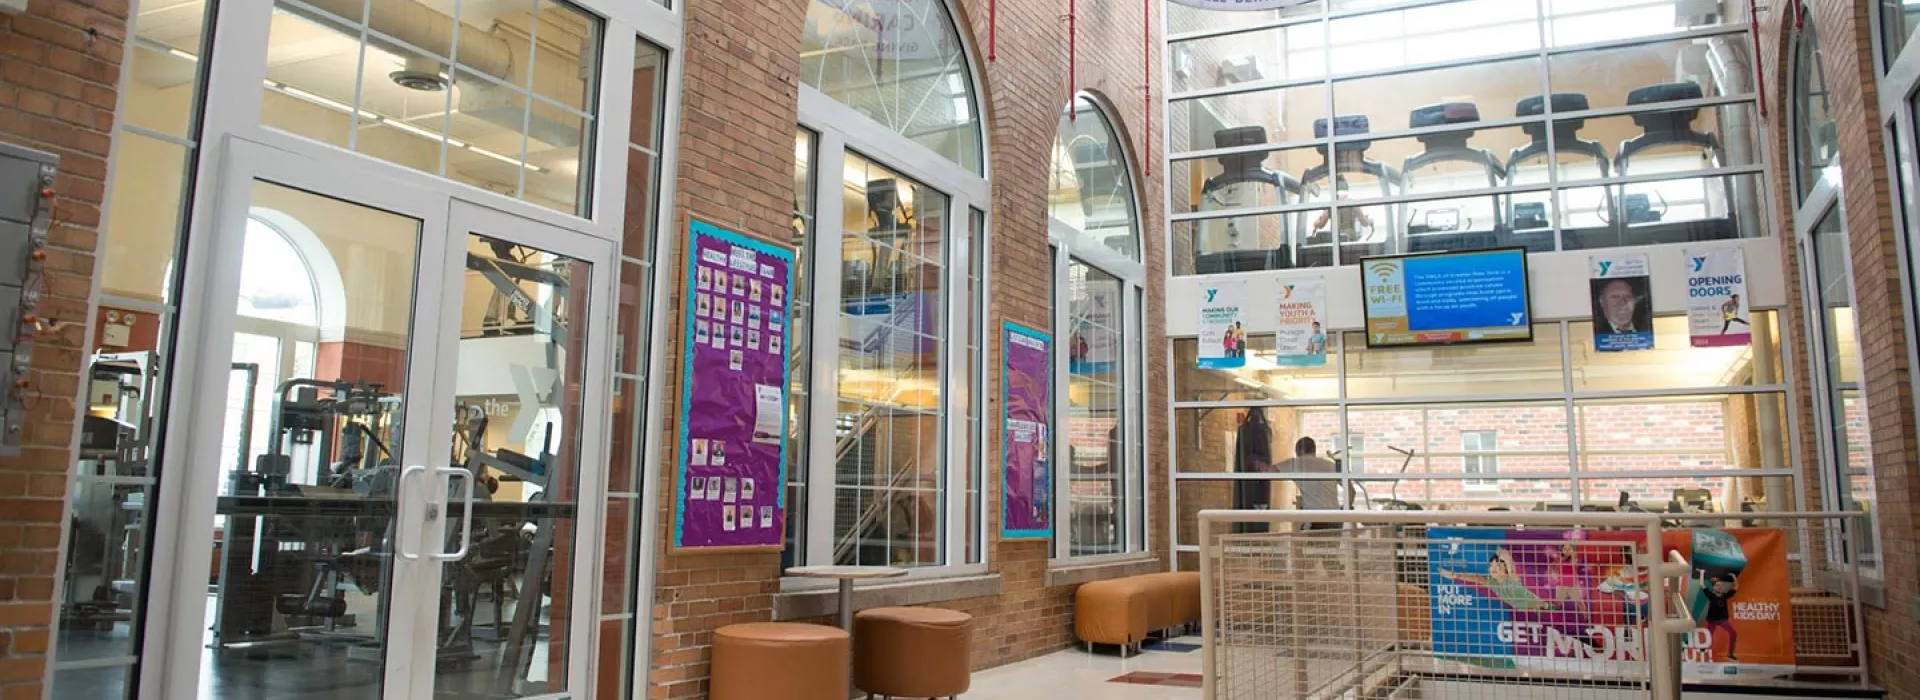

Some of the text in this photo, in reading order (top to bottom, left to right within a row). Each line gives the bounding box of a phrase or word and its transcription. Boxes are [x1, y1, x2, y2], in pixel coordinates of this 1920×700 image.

[1688, 274, 1742, 287] OPENING
[1370, 284, 1401, 295] FREE
[1689, 286, 1733, 298] DOORS
[1371, 294, 1402, 304] WI-FI
[1279, 309, 1309, 317] YOUTH
[485, 398, 509, 417] the
[1437, 585, 1460, 595] PUT
[1438, 594, 1472, 606] MORE
[1732, 602, 1780, 611] HEALTHY
[1733, 612, 1756, 620] KIDS
[1497, 621, 1544, 644] GET
[1546, 625, 1649, 661] MOR
